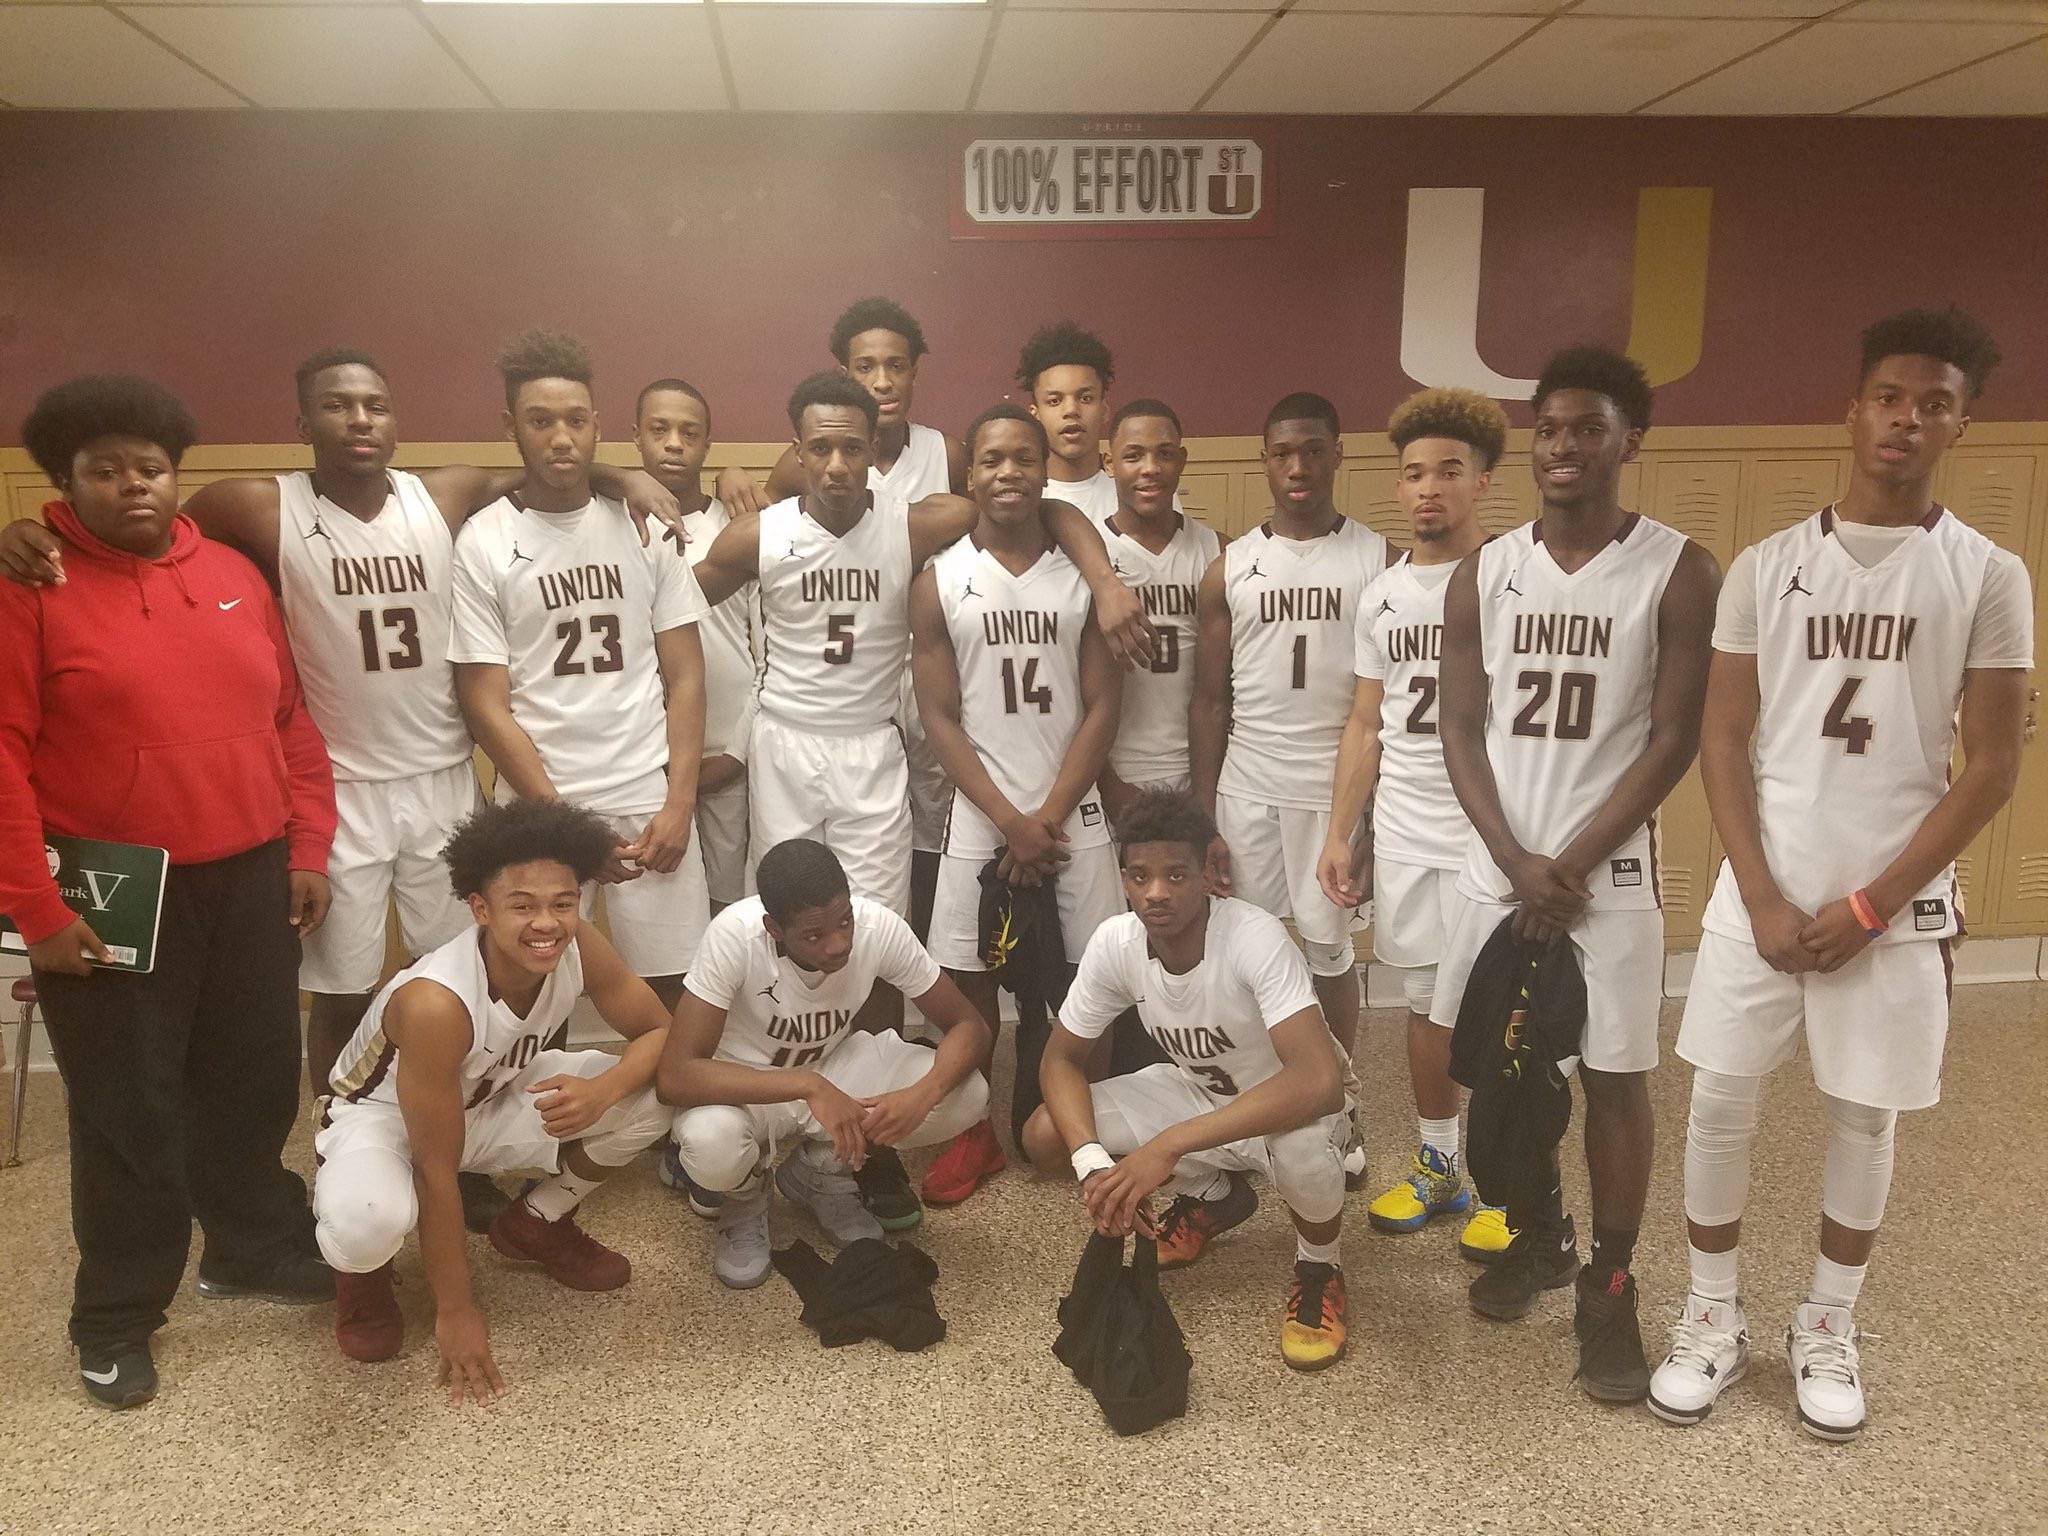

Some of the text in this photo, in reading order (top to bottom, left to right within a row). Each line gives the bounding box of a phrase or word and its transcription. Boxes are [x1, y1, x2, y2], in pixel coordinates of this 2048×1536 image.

[971, 145, 1203, 214] 100% EFFORT
[1218, 145, 1247, 173] ST
[331, 555, 428, 596] UNION
[538, 564, 624, 610] UNION
[802, 568, 880, 602] UNION
[1260, 587, 1342, 623] UNION
[357, 606, 424, 672] 13
[553, 613, 625, 677] 23
[824, 614, 855, 665] 5
[982, 610, 1058, 646] UNION
[1388, 624, 1444, 663] UNIO
[1513, 614, 1613, 658] UNION
[1807, 612, 1918, 661] UNION
[1292, 634, 1307, 689] 1
[1001, 657, 1053, 714] 14
[1406, 675, 1437, 735] 2
[1512, 670, 1597, 740] 20
[1821, 677, 1874, 755] 4
[1620, 861, 1633, 870] M
[60, 869, 130, 912] ark V
[1923, 902, 1937, 913] M
[767, 1009, 851, 1043] UNION
[1188, 1065, 1239, 1096] 3
